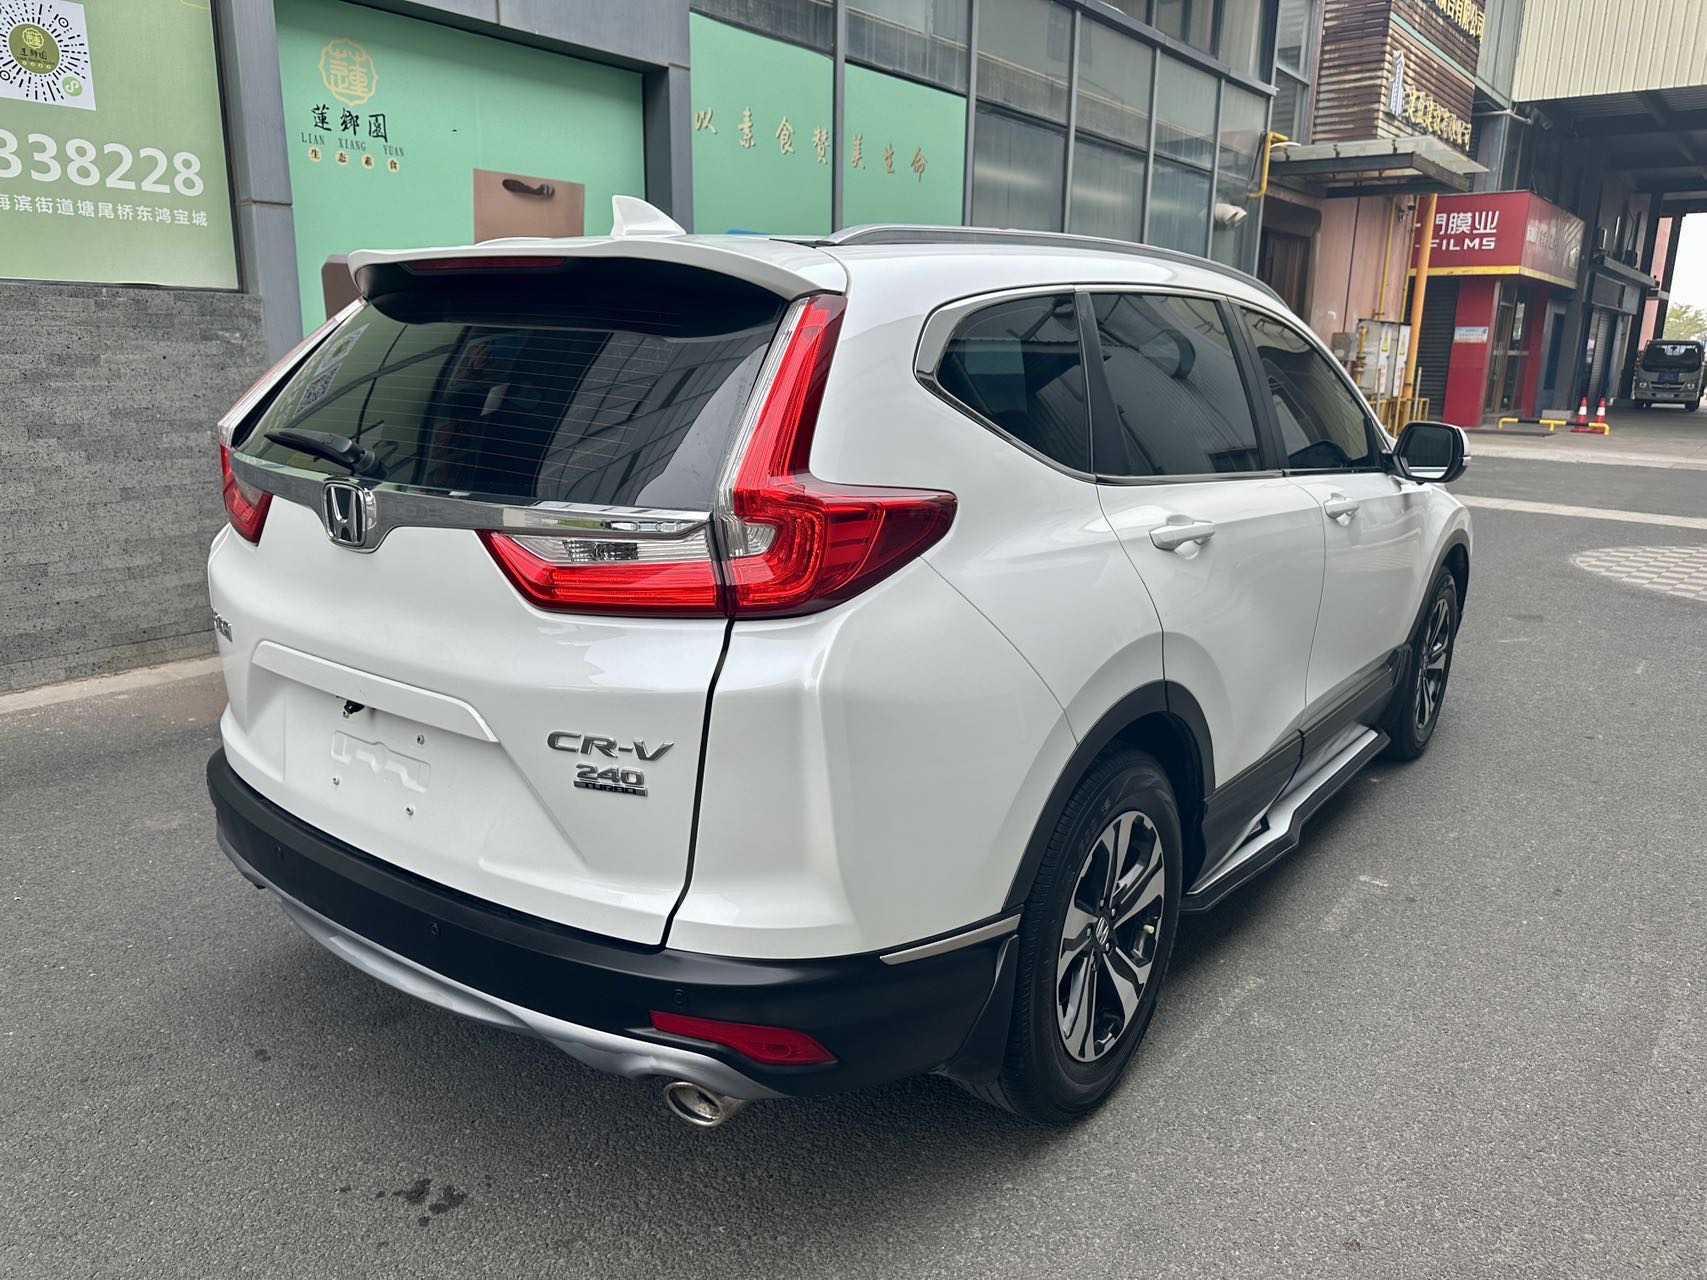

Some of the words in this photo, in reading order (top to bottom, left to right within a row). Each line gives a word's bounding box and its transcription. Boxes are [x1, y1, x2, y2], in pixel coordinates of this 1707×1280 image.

[301, 132, 325, 145] LIAN
[338, 138, 366, 151] XIANG
[547, 731, 674, 761] CR-V
[576, 763, 645, 786] 240
